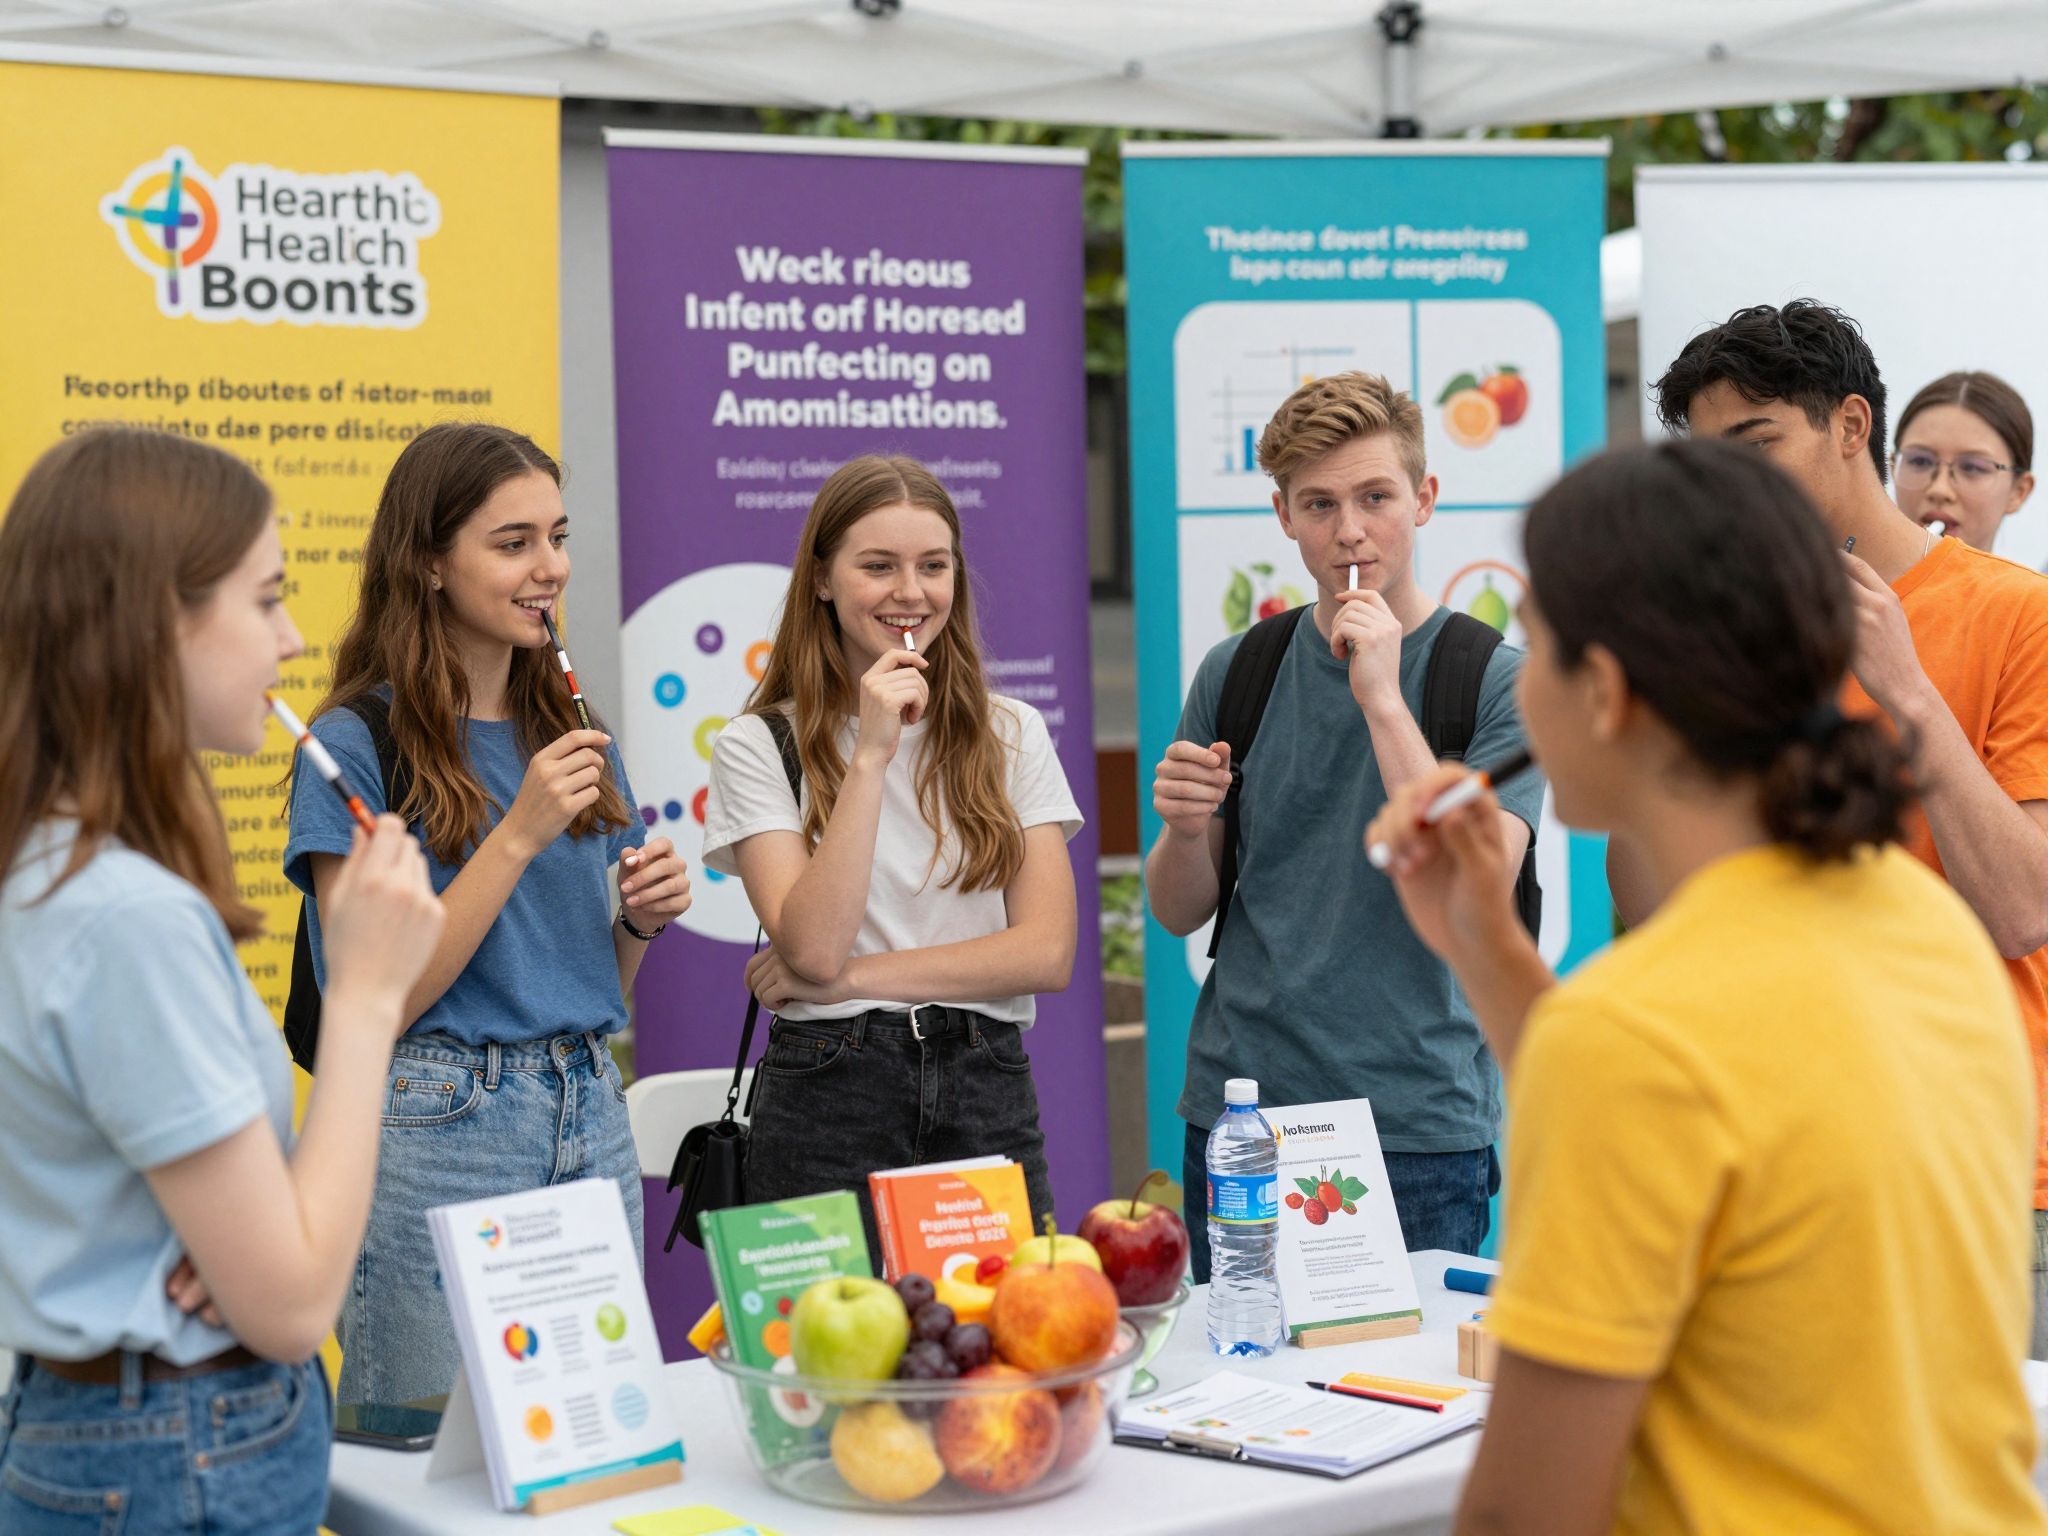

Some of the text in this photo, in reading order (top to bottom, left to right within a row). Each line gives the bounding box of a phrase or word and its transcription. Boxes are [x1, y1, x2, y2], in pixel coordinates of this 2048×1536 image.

[736, 246, 845, 285] Weck
[201, 263, 415, 316] Boonts
[685, 293, 805, 331] Infent
[874, 299, 1025, 335] Horesed
[728, 342, 991, 388] Punfecting on
[319, 379, 345, 402] of
